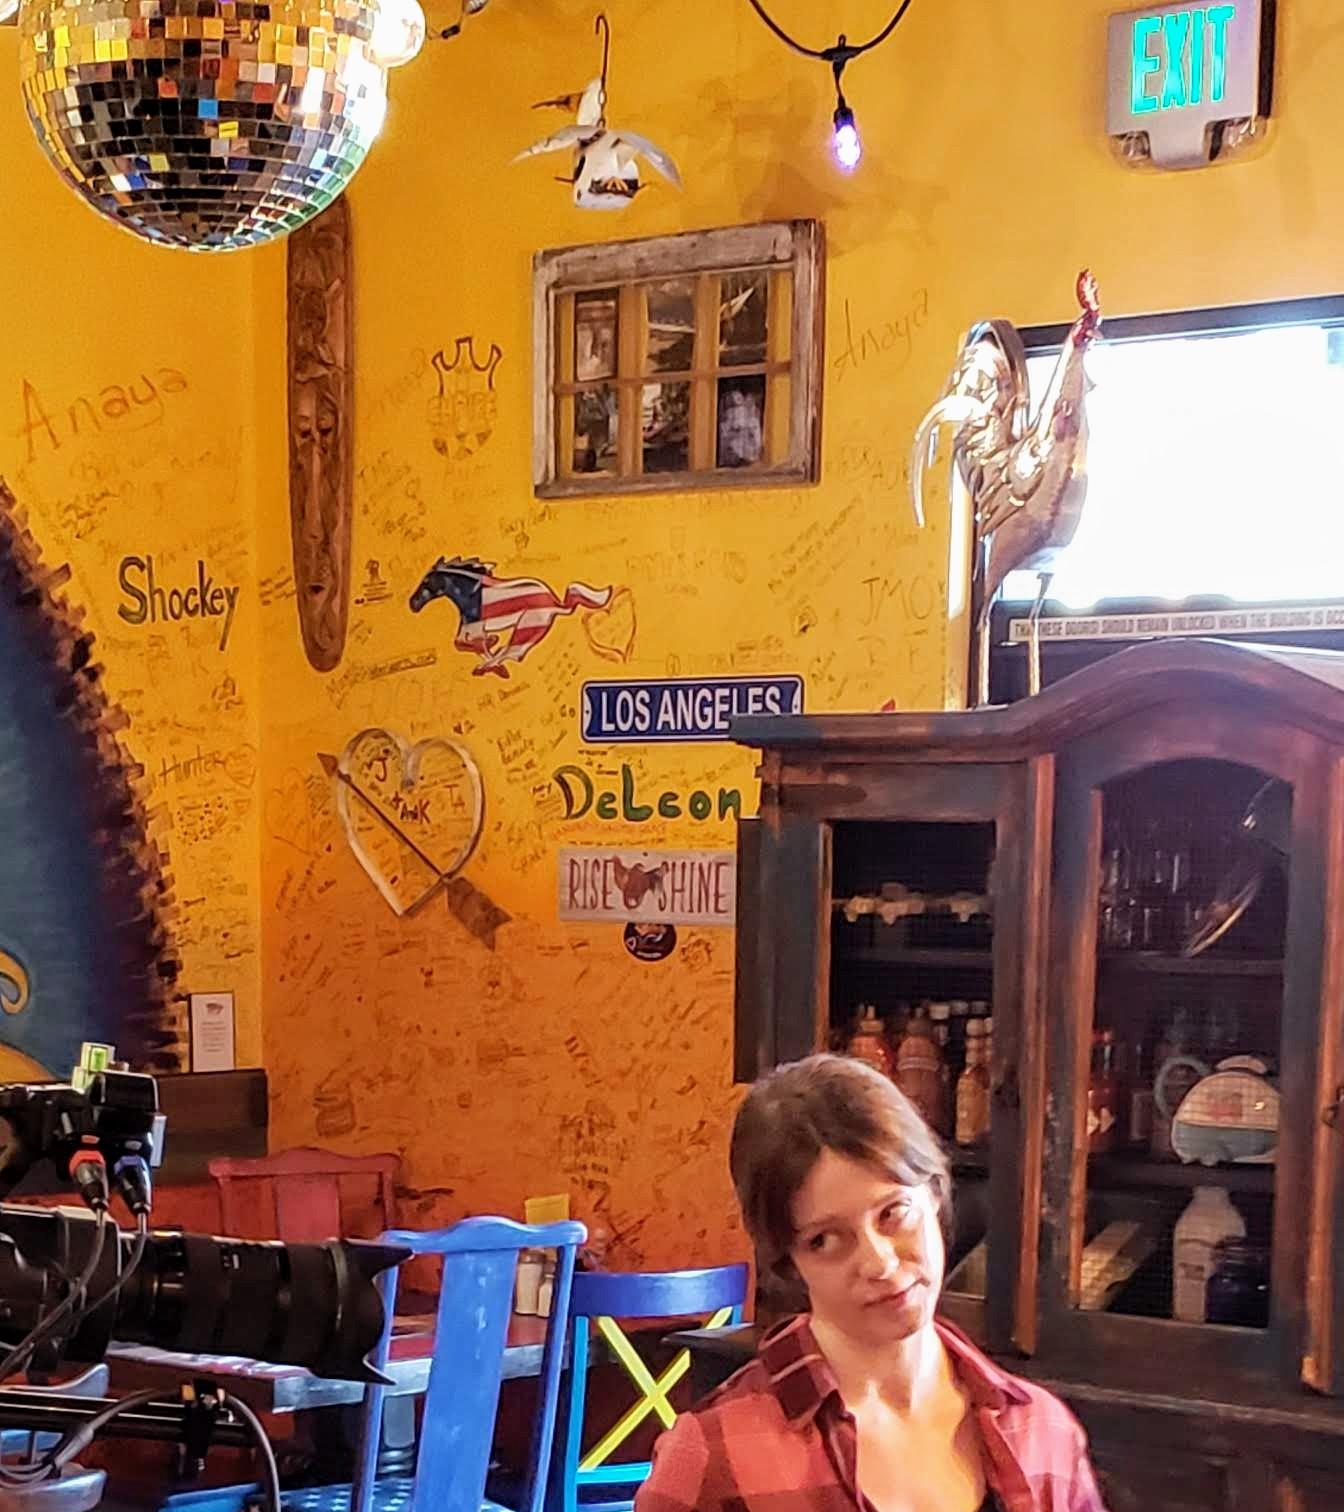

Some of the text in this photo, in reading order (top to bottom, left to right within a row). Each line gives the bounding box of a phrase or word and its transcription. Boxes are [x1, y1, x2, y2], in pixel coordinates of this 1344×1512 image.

[1130, 5, 1236, 114] EXIT
[17, 368, 188, 463] Anaya
[117, 554, 241, 652] Shockey
[600, 684, 782, 732] LOS ANGELES
[568, 857, 615, 910] RISE
[657, 860, 730, 914] SHINE
